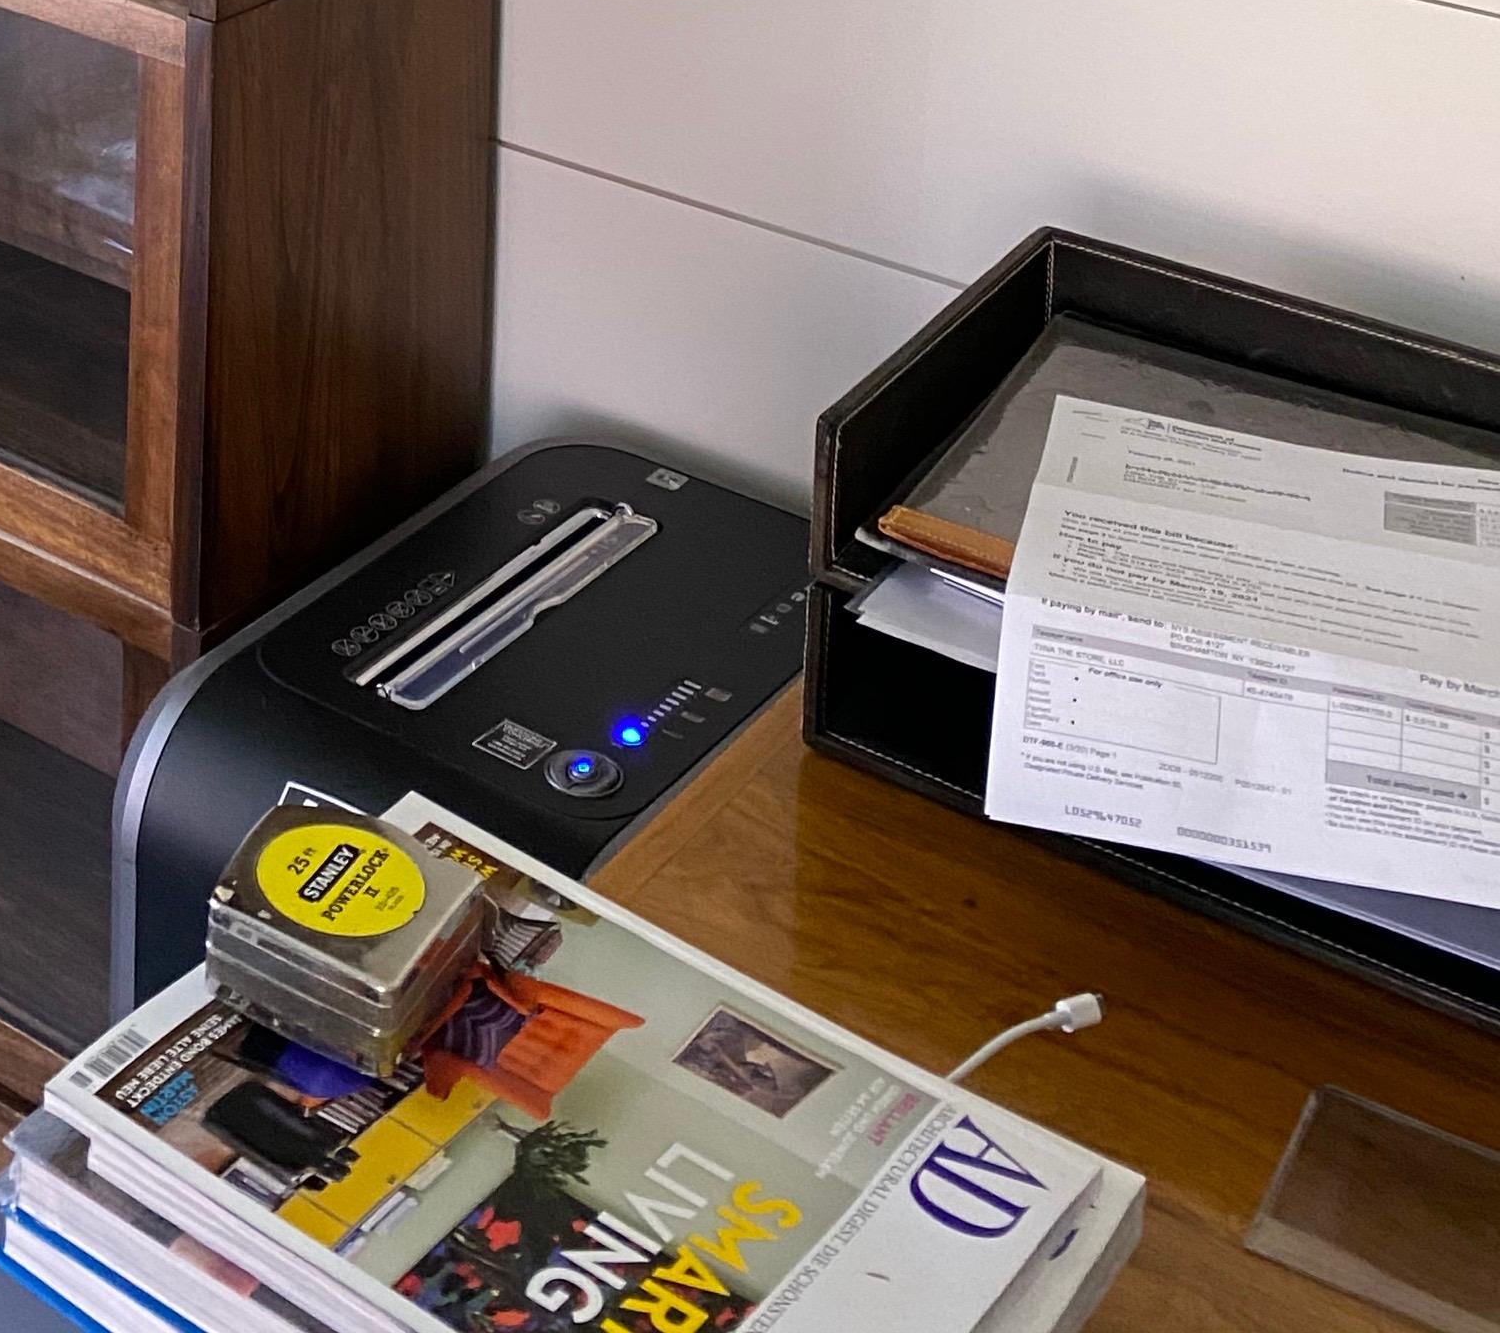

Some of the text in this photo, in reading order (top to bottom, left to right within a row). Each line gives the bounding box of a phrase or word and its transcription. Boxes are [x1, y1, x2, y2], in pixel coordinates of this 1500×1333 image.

[1050, 600, 1082, 613] paying
[1084, 606, 1095, 614] by
[1128, 615, 1152, 625] send
[1419, 673, 1443, 687] Pay
[1446, 679, 1462, 692] by
[287, 856, 310, 875] 25
[303, 846, 354, 899] STANLEY
[321, 849, 389, 921] POWERLOCK
[115, 1014, 223, 1101] SEINE ALTE LIEBE NEU
[180, 1037, 213, 1062] BOND
[126, 1060, 183, 1108] ENTDECKT
[869, 1103, 957, 1200] ARCHITECTURAL
[909, 1115, 1050, 1238] AD
[525, 1141, 737, 1324] LIVING
[811, 1244, 840, 1269] DIE
